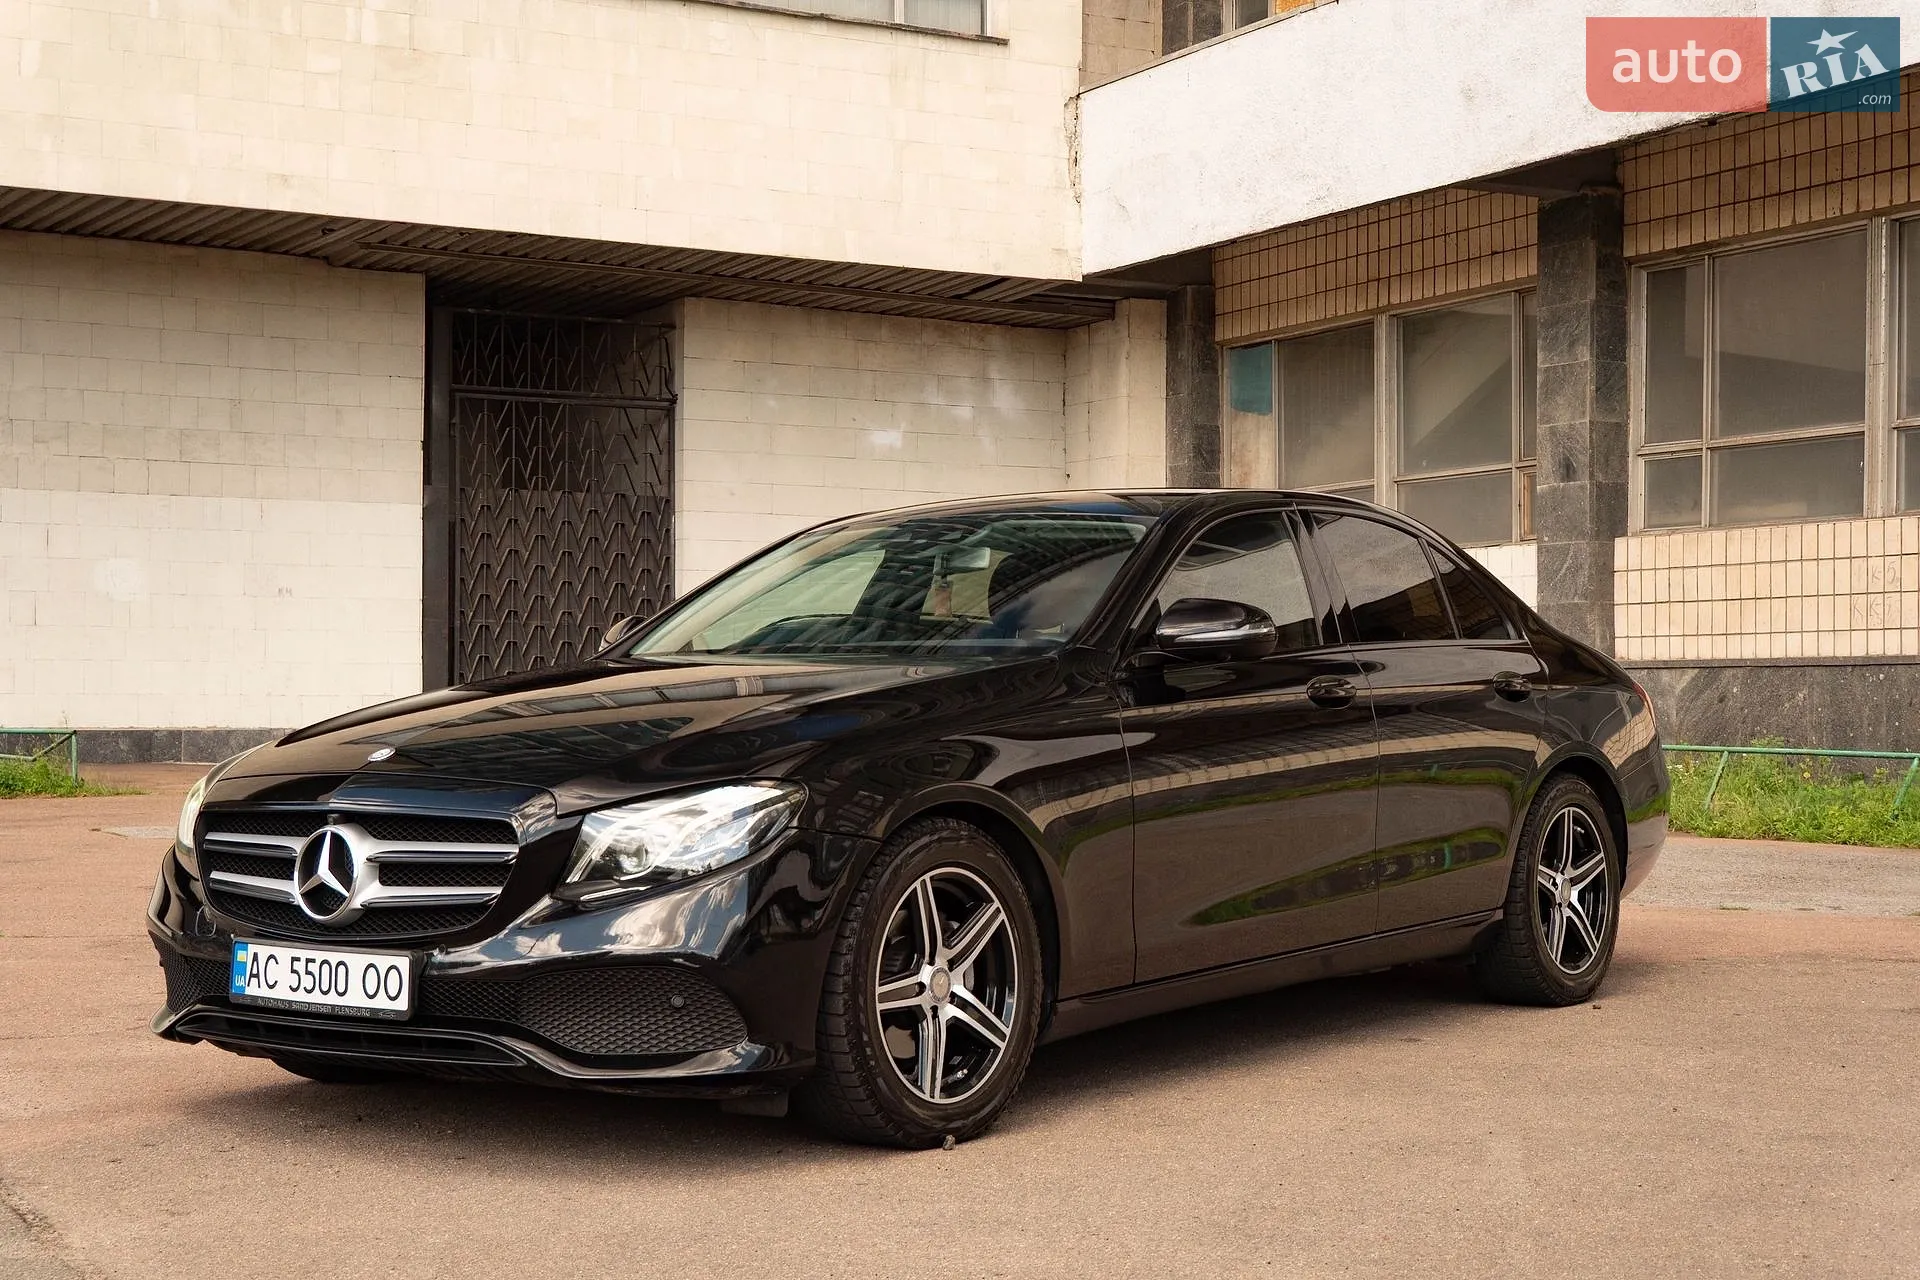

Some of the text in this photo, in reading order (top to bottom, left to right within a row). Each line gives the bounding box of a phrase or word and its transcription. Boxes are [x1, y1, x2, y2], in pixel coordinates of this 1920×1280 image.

[235, 974, 246, 988] UA
[247, 952, 279, 990] AC
[288, 956, 350, 997] 5500
[257, 998, 289, 1009] AUTOHAUS
[335, 1006, 371, 1017] FLENSBURG
